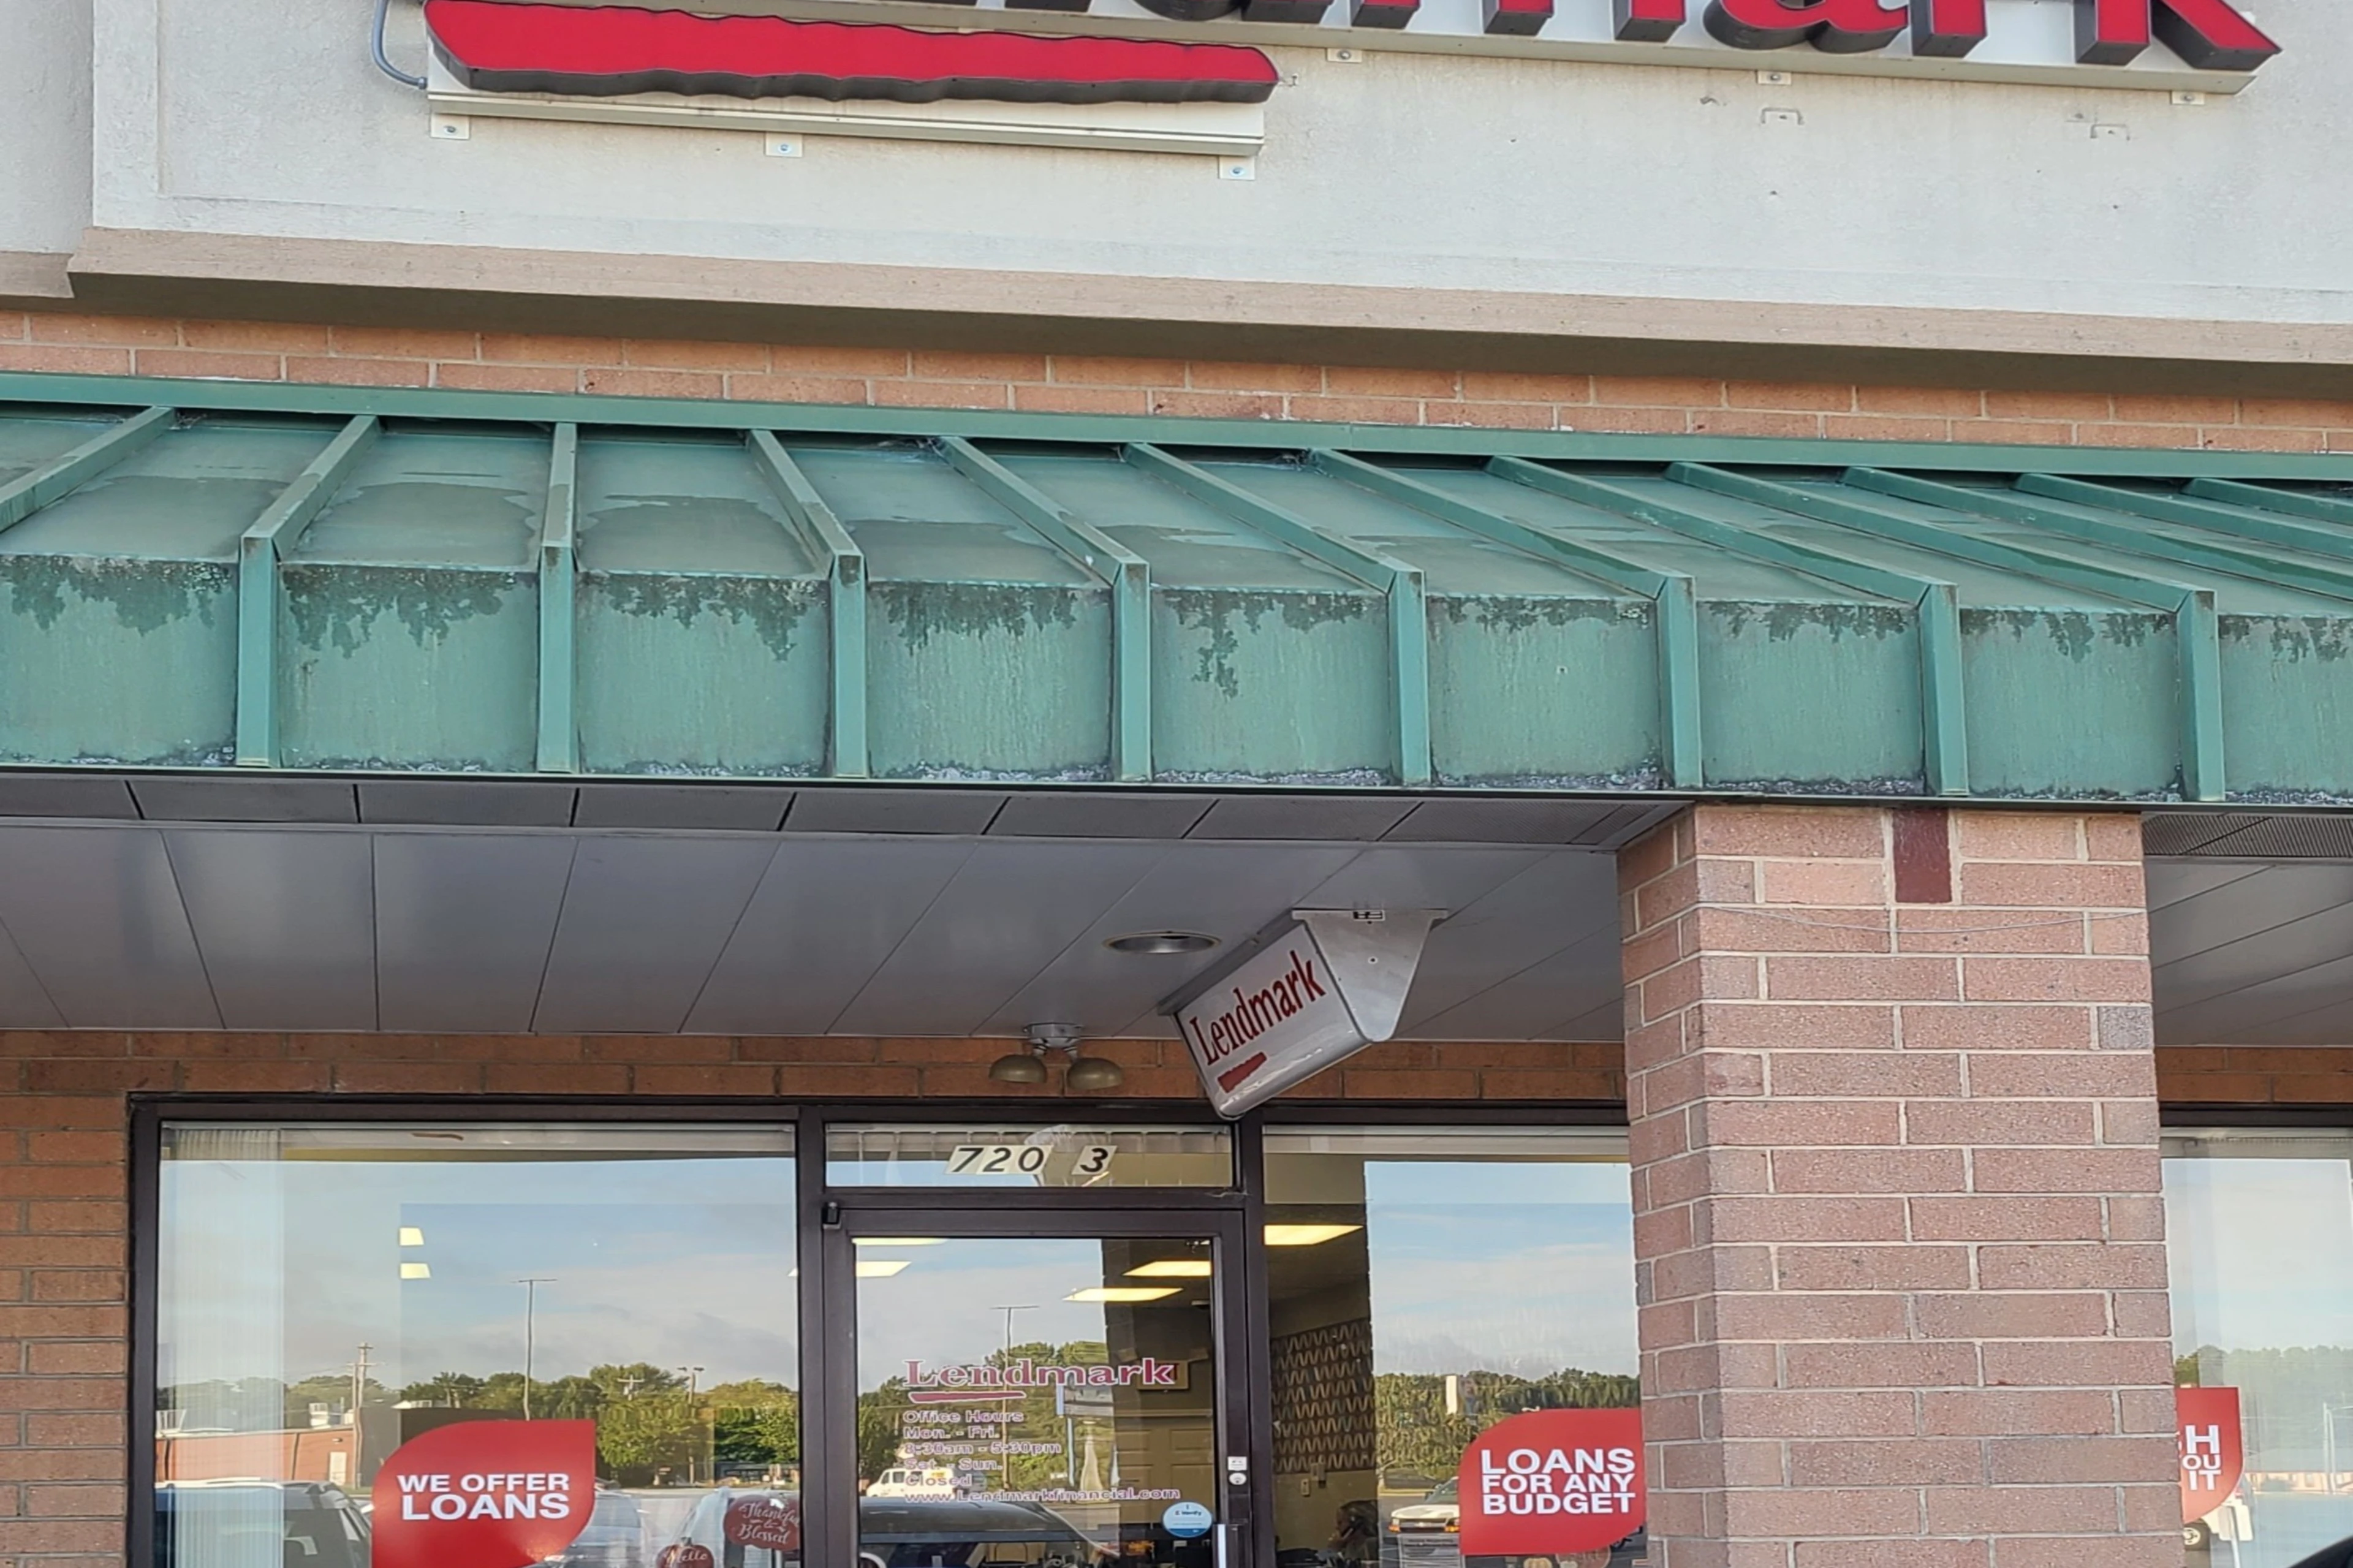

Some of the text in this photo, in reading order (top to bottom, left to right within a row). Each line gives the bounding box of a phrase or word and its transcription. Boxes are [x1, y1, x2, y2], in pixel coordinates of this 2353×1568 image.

[1189, 950, 1327, 1066] Lendmark
[952, 1146, 1108, 1173] 720 3
[903, 1357, 1175, 1387] Lendmark
[903, 1410, 1025, 1423] Office Hours
[903, 1426, 951, 1439] Mon.
[968, 1425, 1000, 1439] Fri.
[1480, 1448, 1636, 1475] LOANS
[396, 1473, 570, 1493] WE OFFER
[905, 1473, 972, 1487] Closed
[1482, 1473, 1635, 1494] FOR ANY
[2189, 1470, 2221, 1491] IT
[402, 1493, 570, 1520] LOANS
[1483, 1493, 1637, 1515] BUDGET
